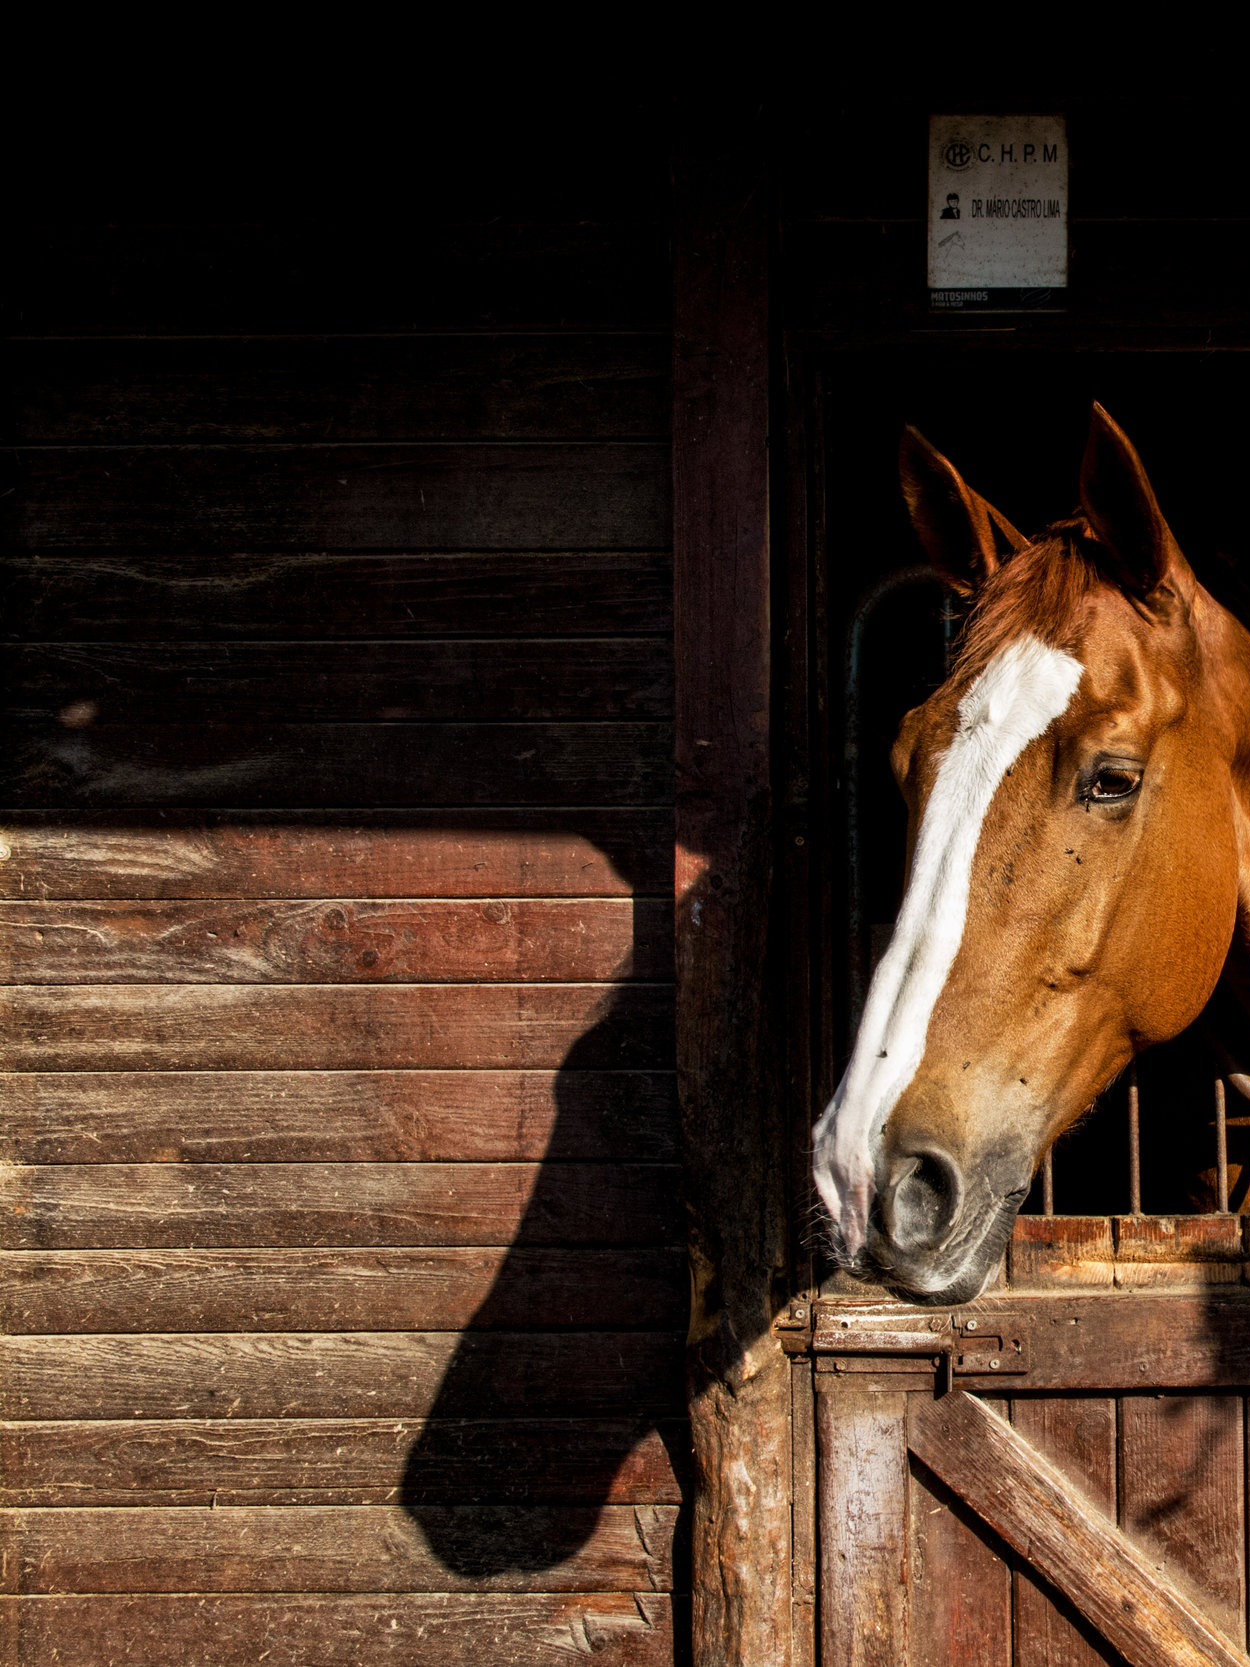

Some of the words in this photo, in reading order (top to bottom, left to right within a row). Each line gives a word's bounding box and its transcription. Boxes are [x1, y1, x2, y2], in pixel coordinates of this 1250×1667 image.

[1043, 143, 1057, 162] M
[972, 199, 984, 218] DR.
[985, 195, 1010, 218] MÁRIO
[1011, 199, 1042, 218] CASTRO
[1043, 199, 1061, 218] LIMA
[931, 290, 989, 302] MATOSINHOS
